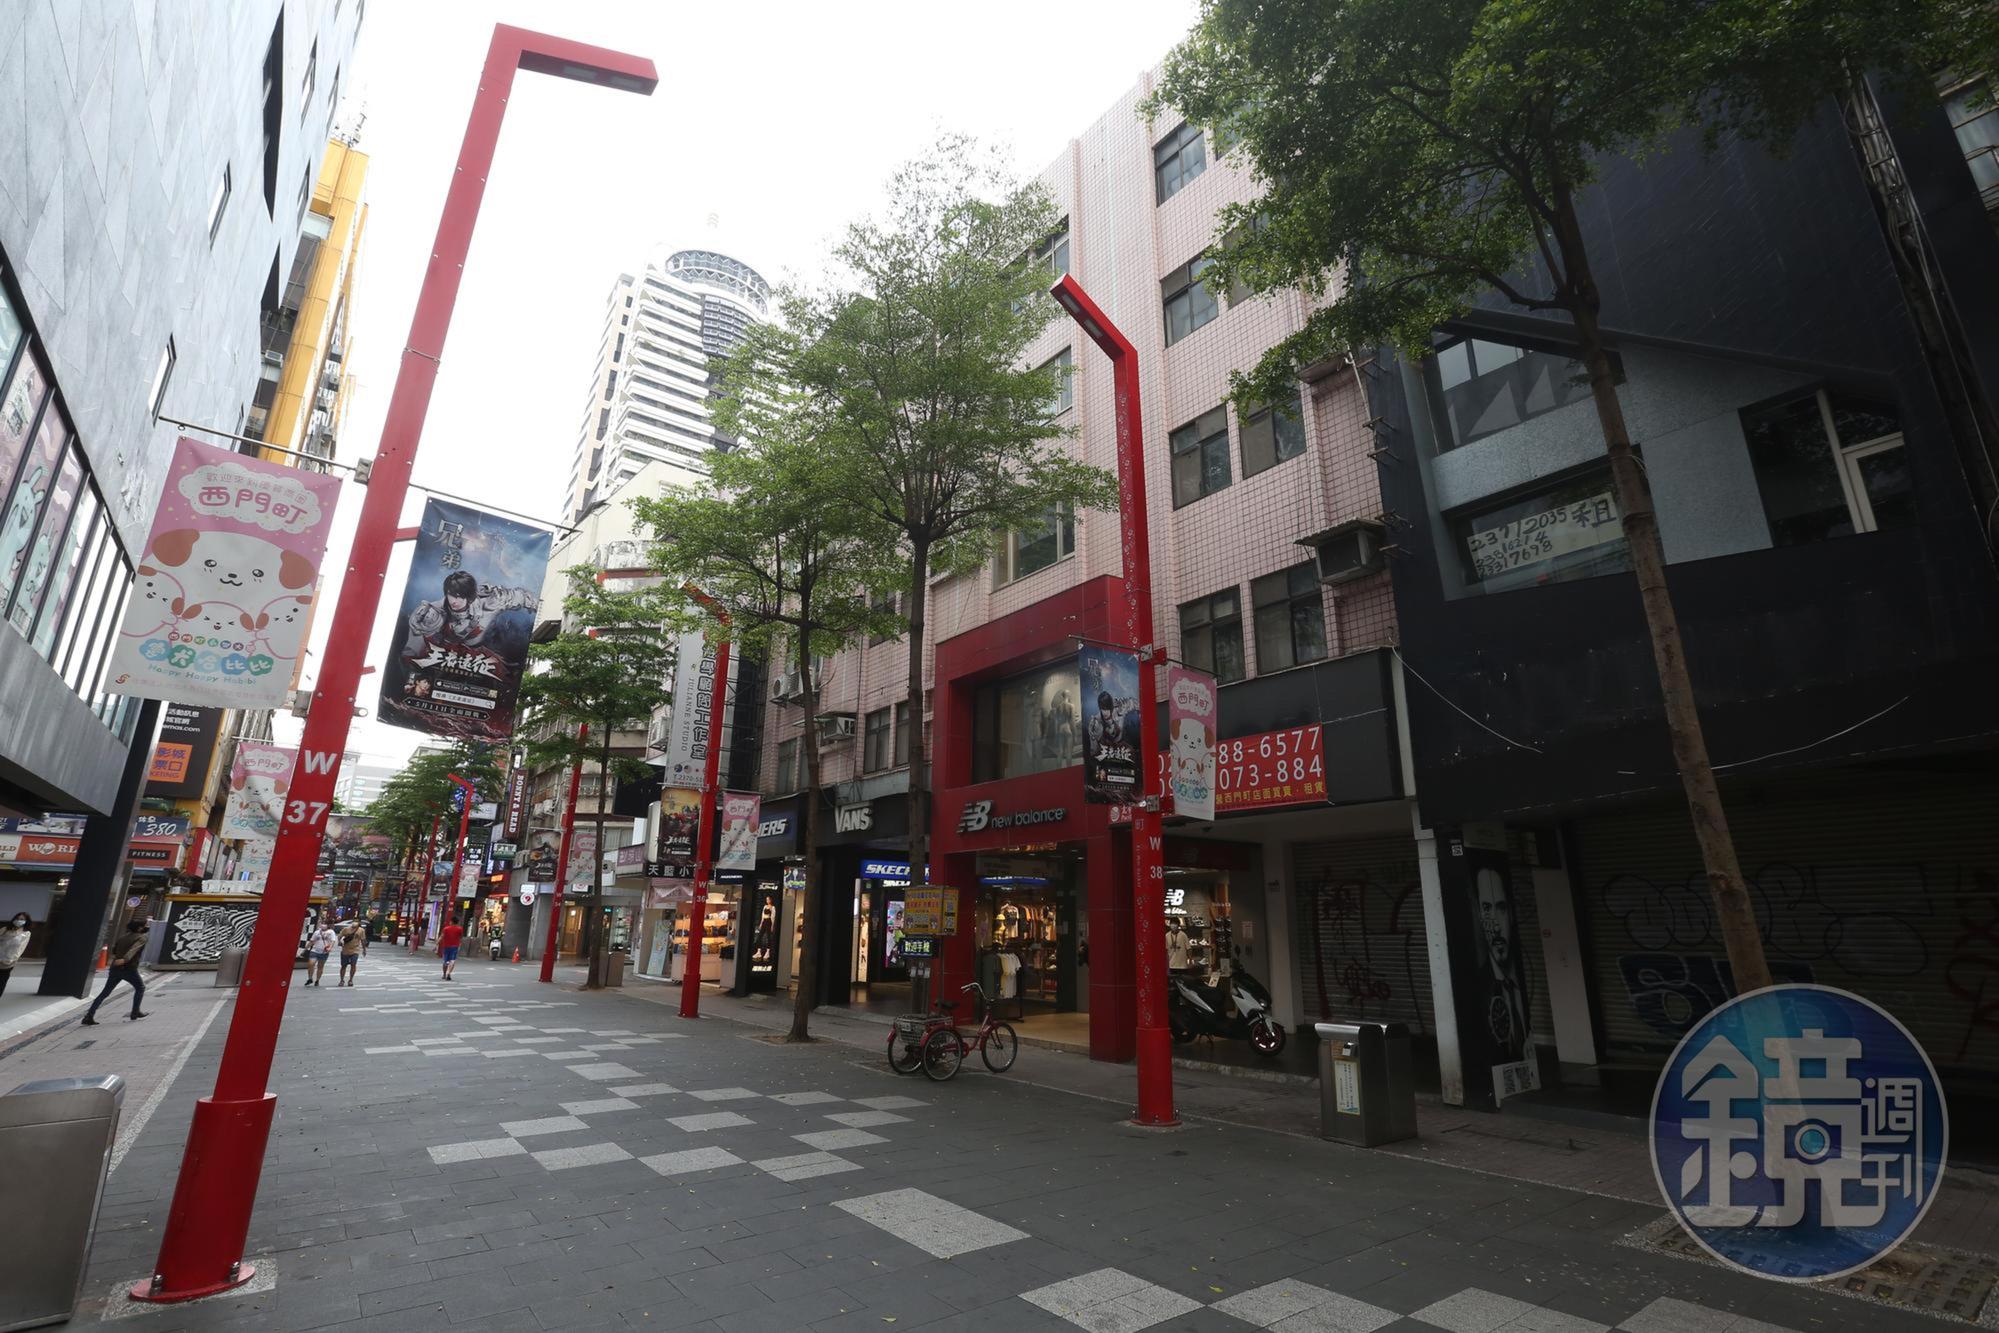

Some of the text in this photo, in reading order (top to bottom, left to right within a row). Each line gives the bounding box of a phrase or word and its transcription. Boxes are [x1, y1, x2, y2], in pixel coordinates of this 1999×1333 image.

[199, 486, 308, 525] 西門町
[1571, 498, 1617, 529] 租
[435, 519, 464, 570] 兄弟
[680, 720, 690, 752] STUDIO
[304, 749, 338, 775] W
[286, 800, 328, 825] 37
[834, 802, 872, 834] VANS
[991, 816, 1012, 829] new
[1015, 807, 1065, 826] balance
[1149, 836, 1161, 851] W
[1150, 866, 1163, 879] 38
